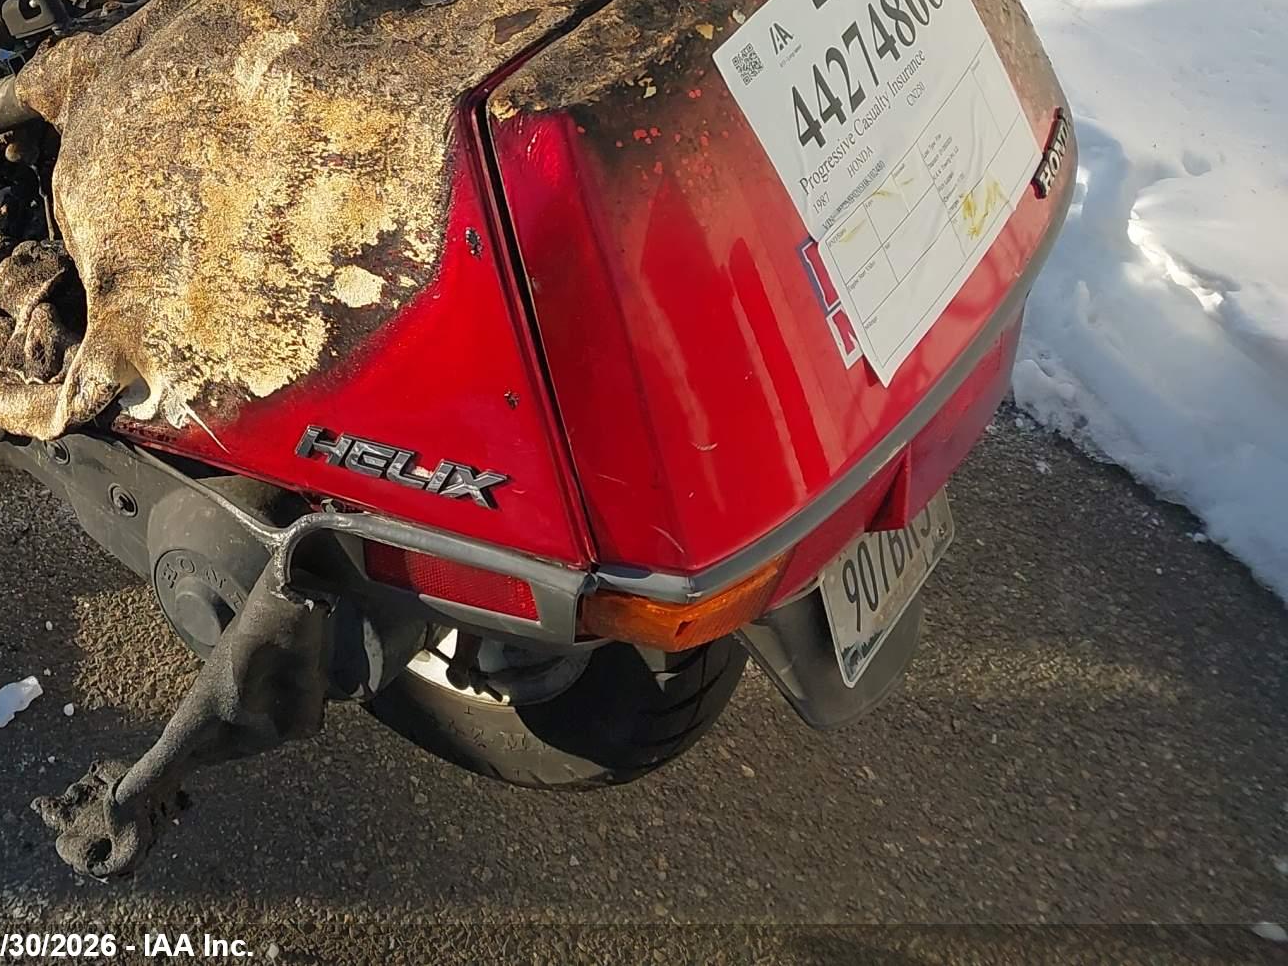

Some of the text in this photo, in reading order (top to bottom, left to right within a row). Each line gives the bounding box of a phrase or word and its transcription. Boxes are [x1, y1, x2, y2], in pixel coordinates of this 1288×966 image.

[799, 132, 857, 197] Progressive
[853, 92, 892, 137] Casualty
[886, 49, 926, 98] Insurance
[813, 190, 831, 215] 1987
[847, 145, 874, 179] HONDA
[906, 81, 926, 108] CN250
[295, 425, 511, 510] HELIX
